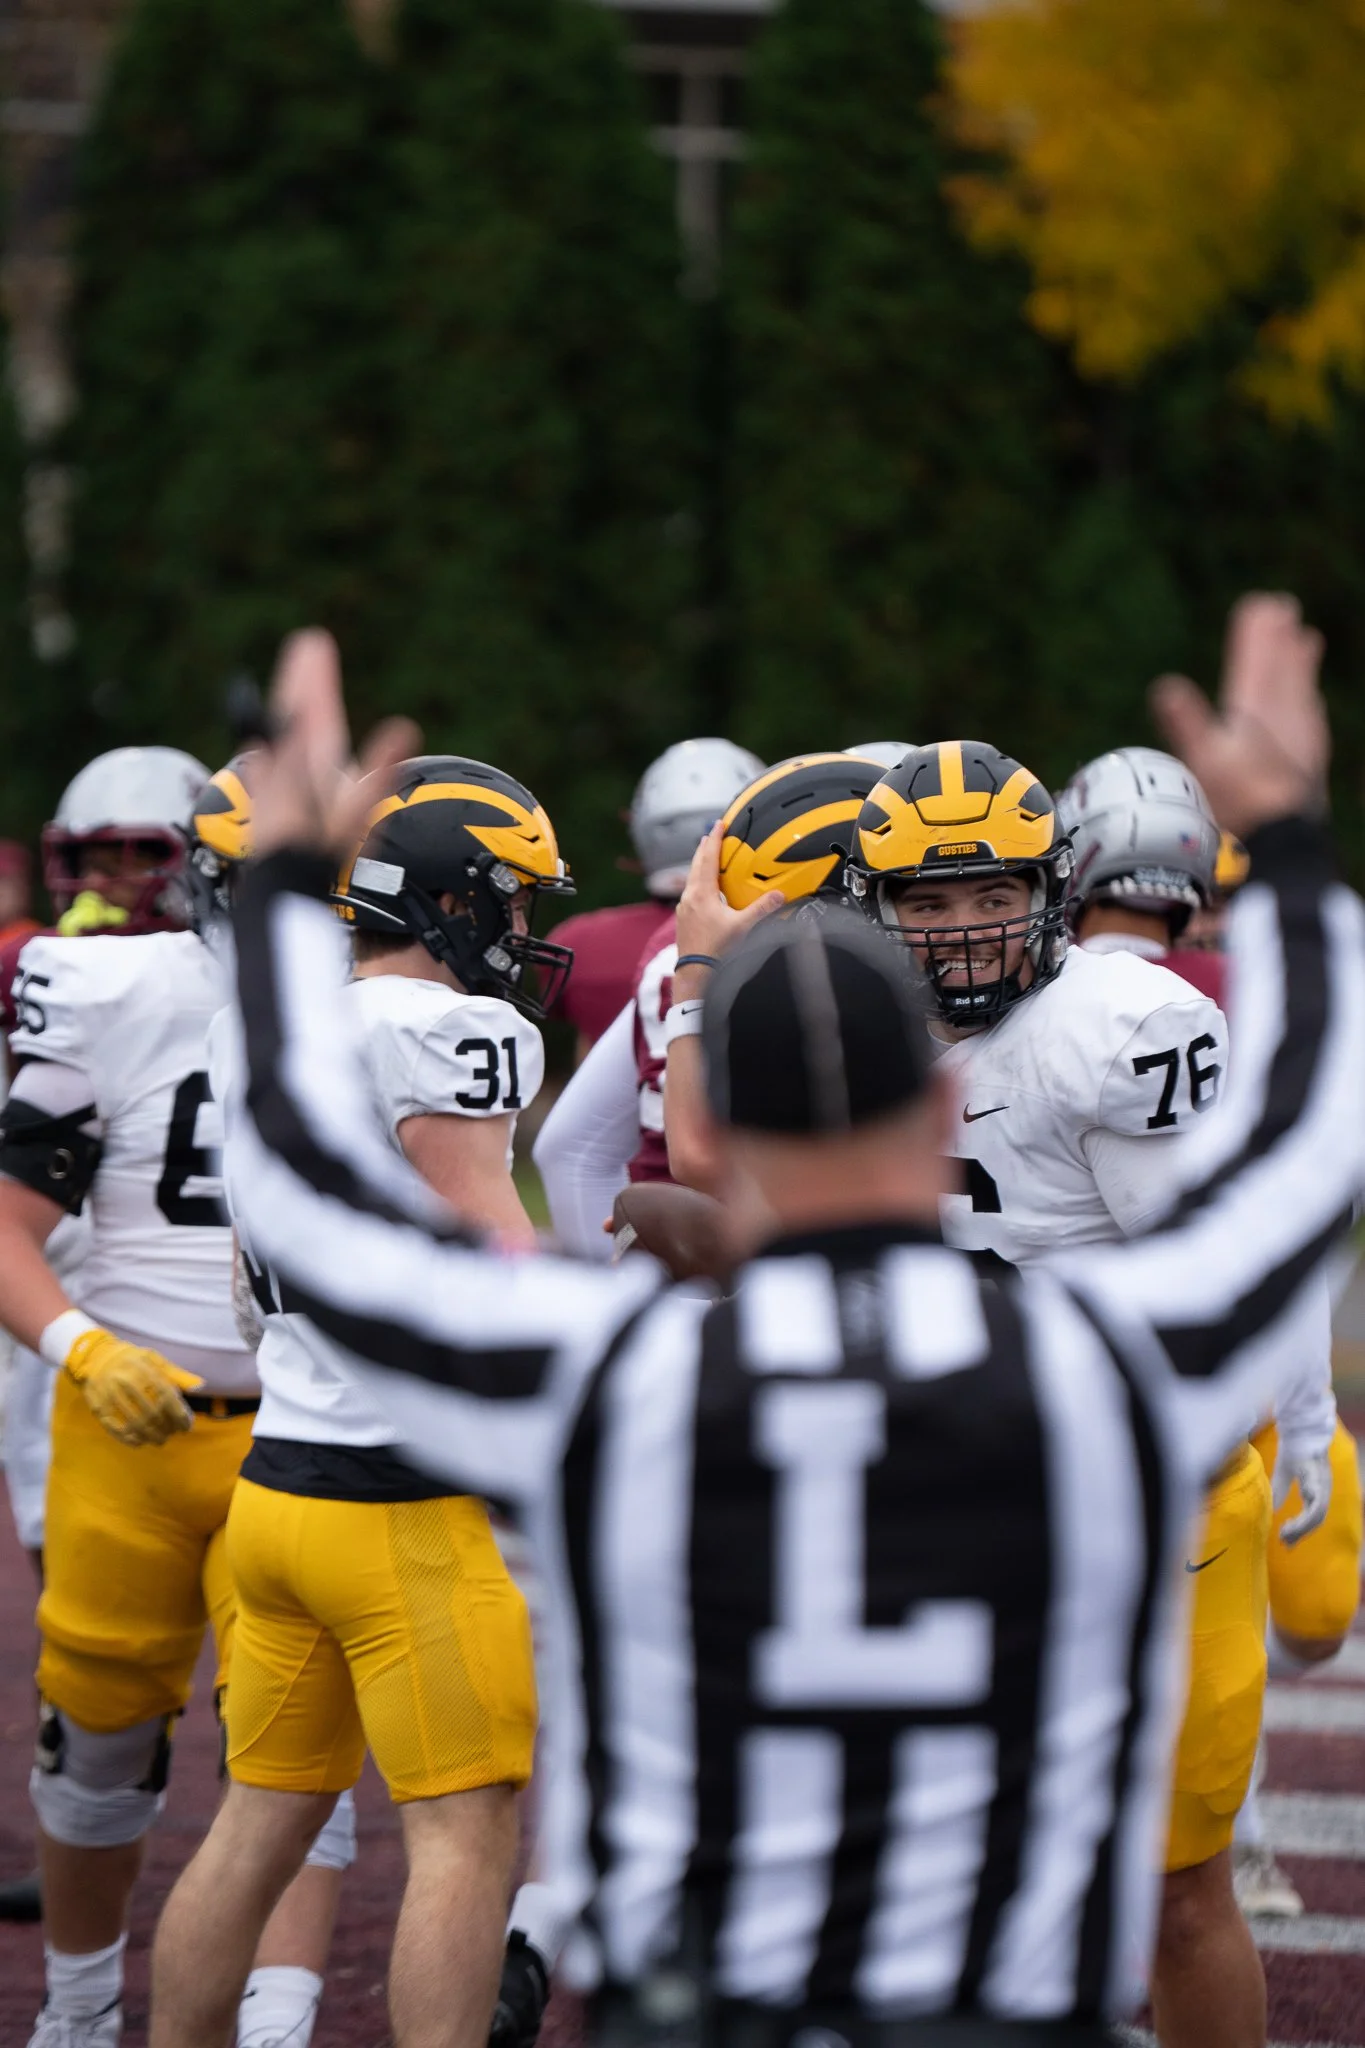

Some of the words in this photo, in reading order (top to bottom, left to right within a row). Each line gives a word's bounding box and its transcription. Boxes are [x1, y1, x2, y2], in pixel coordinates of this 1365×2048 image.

[938, 843, 978, 857] GUSTIES
[955, 995, 985, 1005] Ridell
[455, 1036, 521, 1110] 31
[1132, 1032, 1222, 1130] 76
[753, 1380, 995, 1708] L
